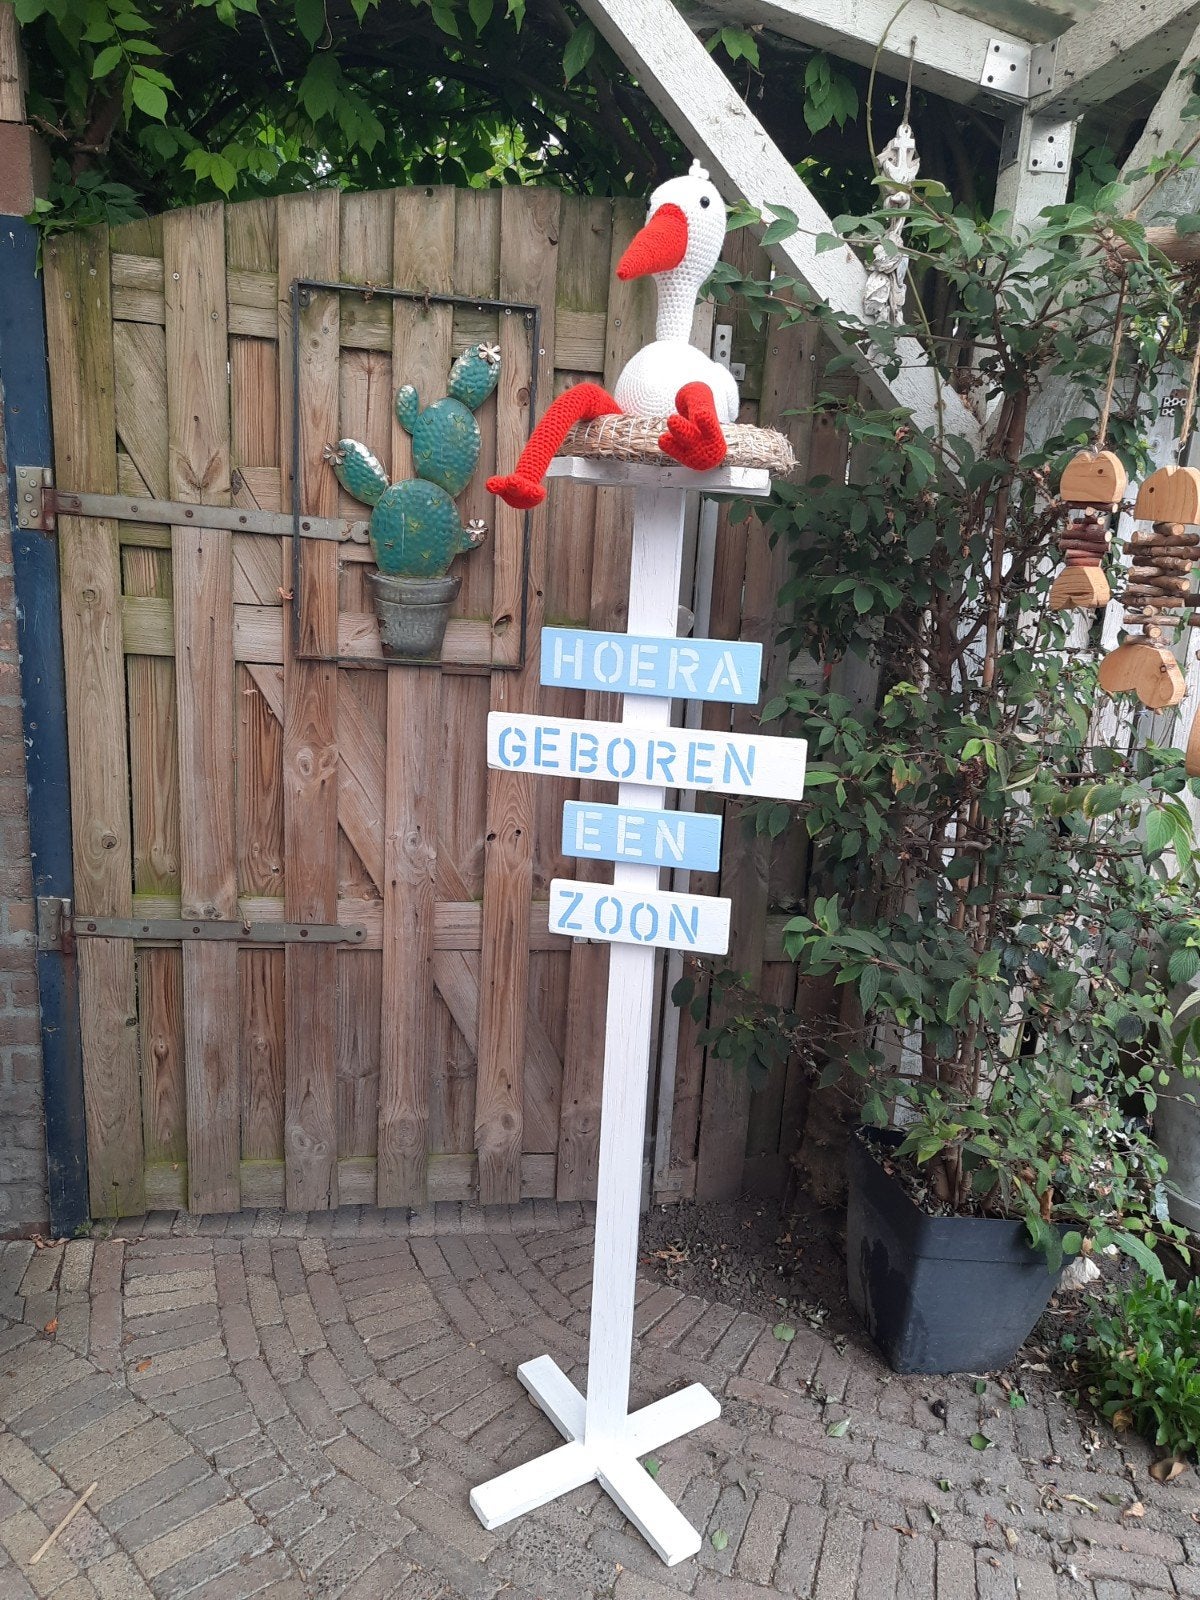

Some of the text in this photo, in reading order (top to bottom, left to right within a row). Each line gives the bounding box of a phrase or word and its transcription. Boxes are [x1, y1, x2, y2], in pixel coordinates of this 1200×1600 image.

[554, 637, 742, 695] HOERA
[498, 727, 756, 786] GEBOREN
[576, 810, 685, 862] EEN
[557, 891, 699, 944] ZOON
